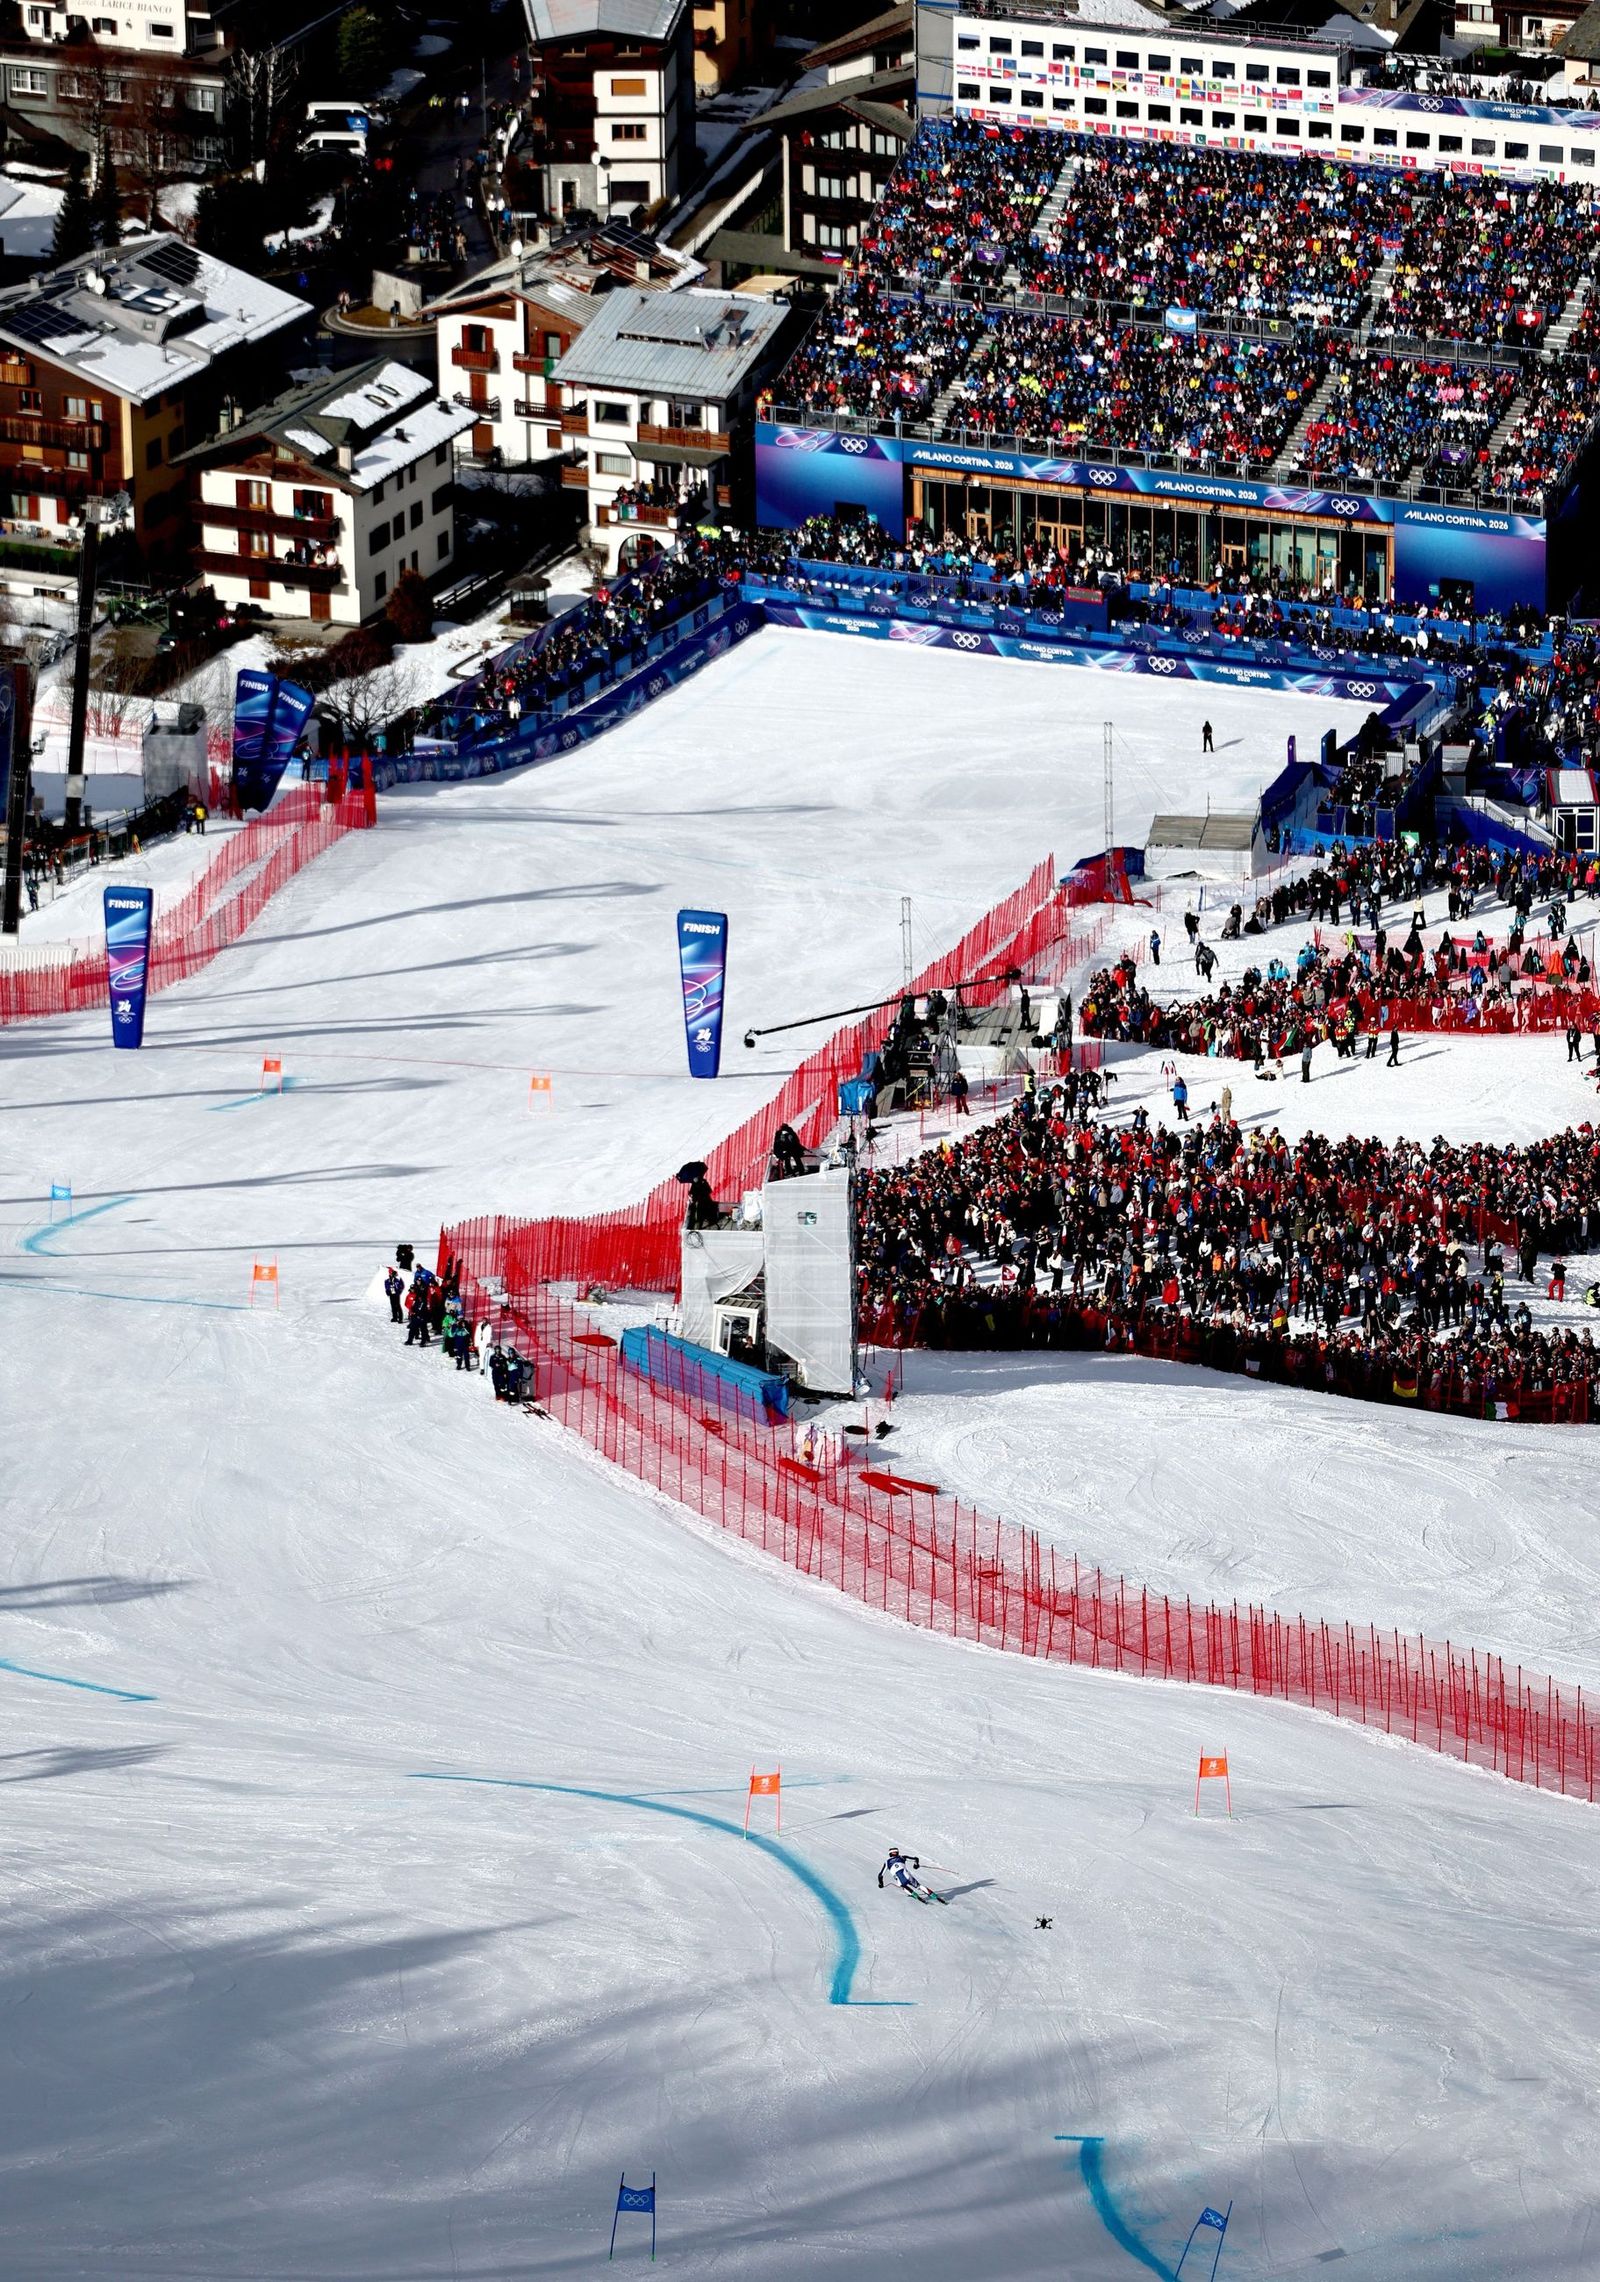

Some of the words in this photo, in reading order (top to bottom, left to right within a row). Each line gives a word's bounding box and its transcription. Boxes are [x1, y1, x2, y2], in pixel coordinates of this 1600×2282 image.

[137, 2, 172, 14] BIANCO
[1492, 106, 1515, 114] MILANO
[1515, 108, 1539, 116] CORTINA
[913, 450, 952, 463] MILANO
[953, 455, 993, 469] CORTINA
[994, 460, 1014, 471] 2026
[1155, 481, 1194, 493] MILANO
[1196, 485, 1236, 498] CORTINA
[1238, 490, 1258, 501] 2026
[1405, 511, 1444, 523] MILANO
[1446, 514, 1487, 528] CORTINA
[1489, 519, 1509, 530] 2026
[826, 617, 852, 626] MILANO
[853, 620, 880, 629] CORTINA
[1020, 643, 1046, 654] MILANO
[1047, 647, 1074, 657] CORTINA
[1216, 666, 1243, 676] MILANO
[1244, 669, 1271, 680] CORTINA
[240, 679, 269, 693] FINISH
[278, 691, 307, 712] FINISH
[109, 899, 144, 910] FINISH
[683, 922, 721, 935] FINISH
